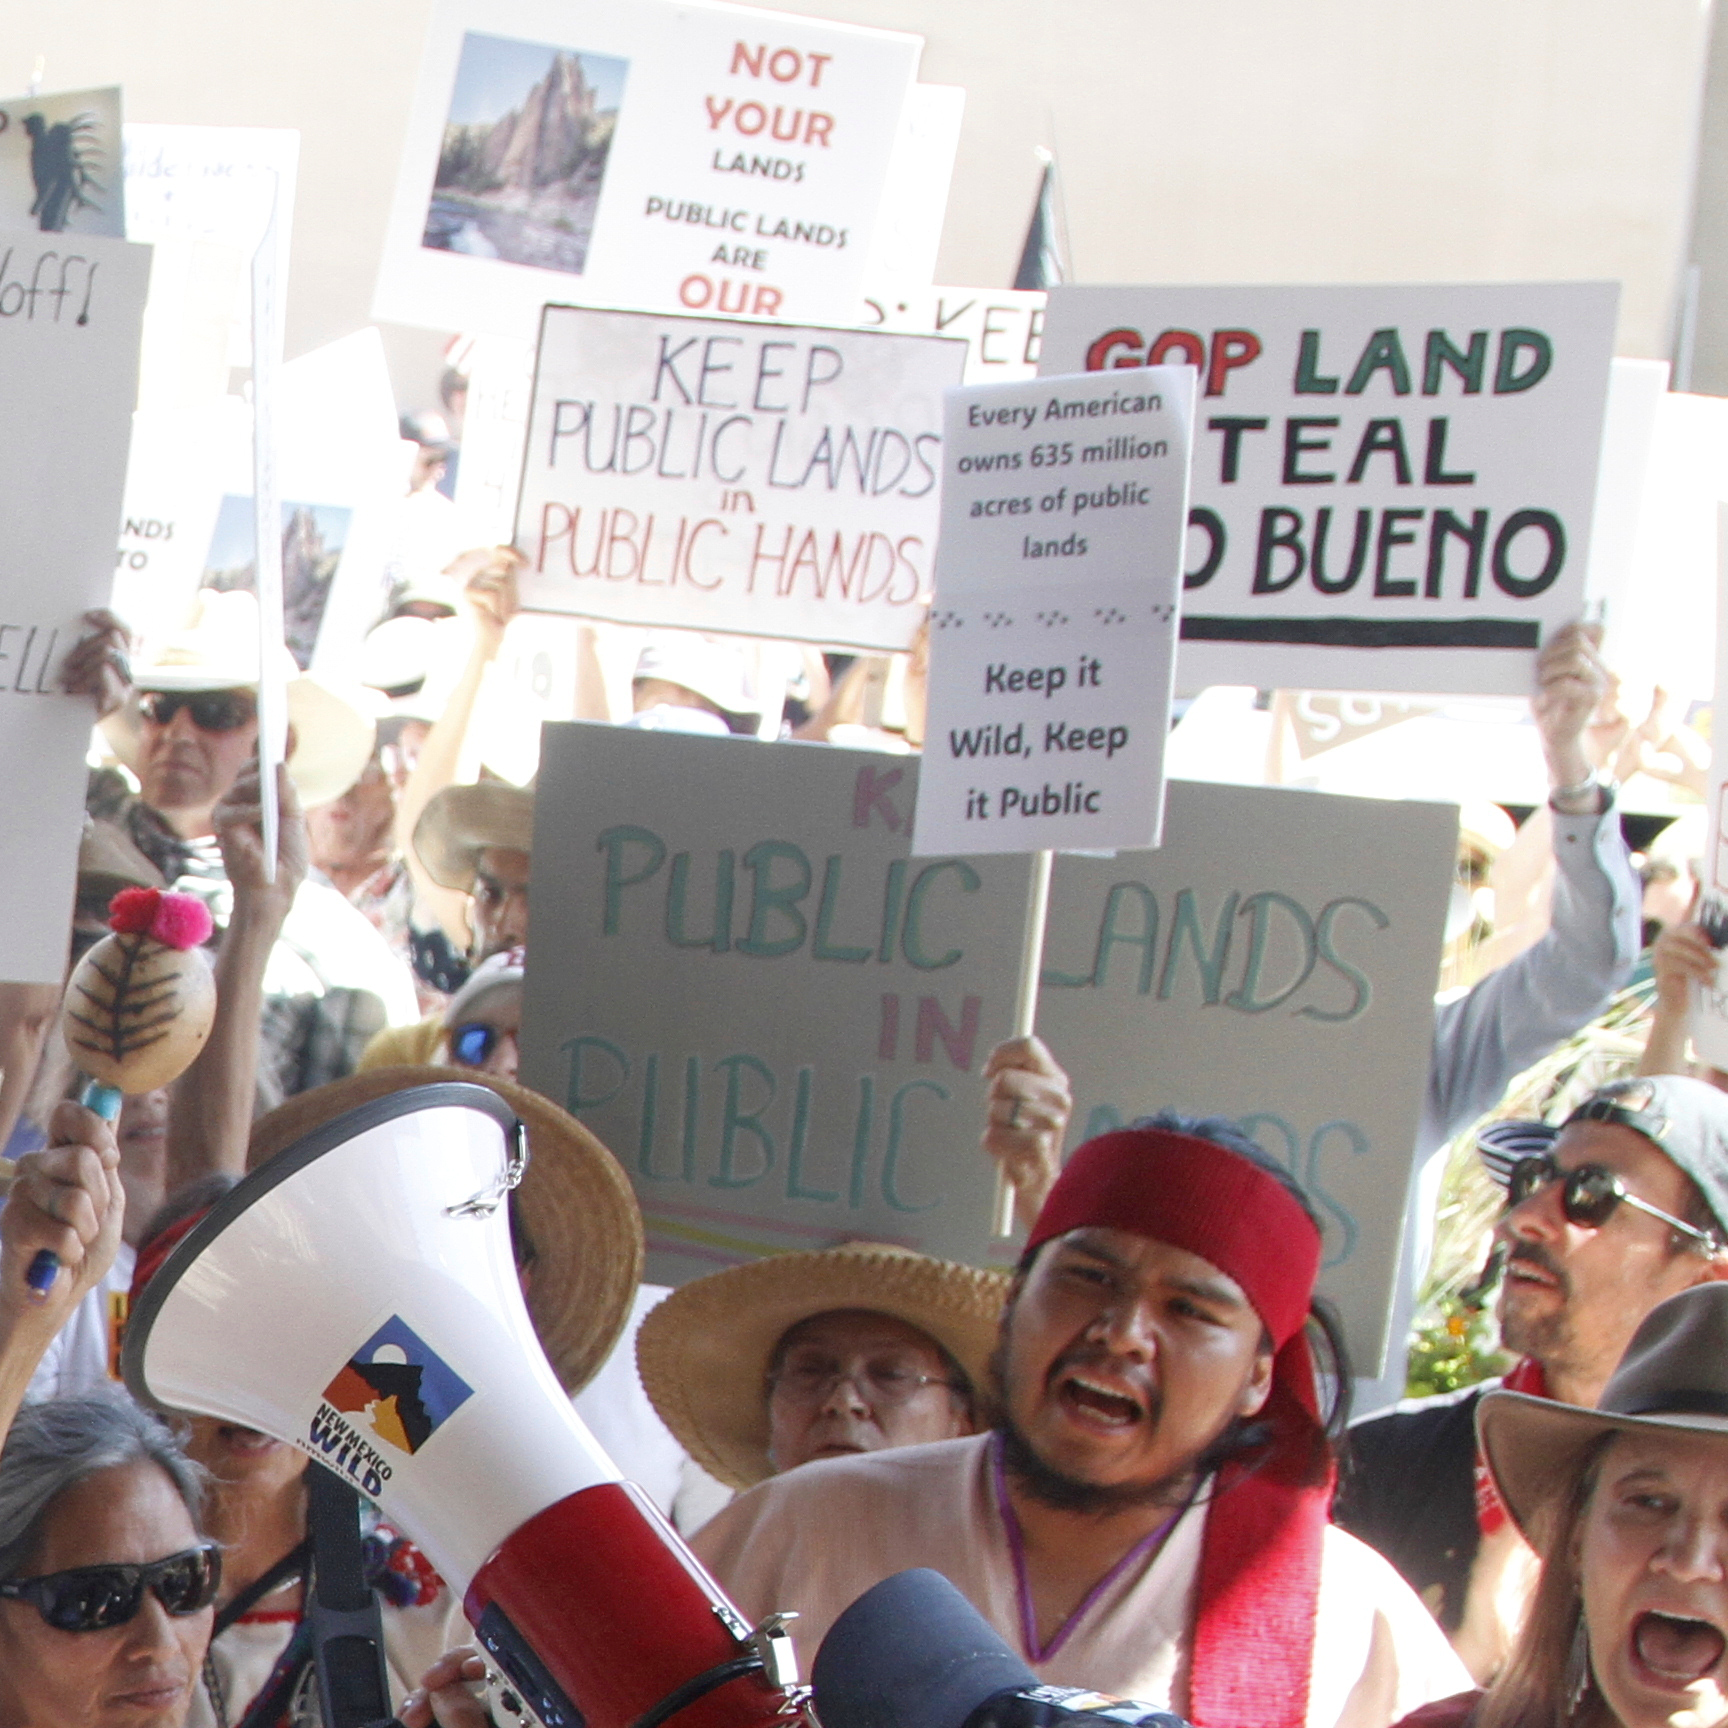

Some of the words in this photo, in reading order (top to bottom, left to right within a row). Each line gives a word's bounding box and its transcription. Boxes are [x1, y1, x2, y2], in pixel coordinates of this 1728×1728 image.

[729, 41, 834, 88] NOT
[703, 94, 836, 149] YOUR
[712, 150, 809, 183] LANDS
[643, 196, 747, 233] PUBLIC
[754, 213, 851, 251] LANDS
[710, 243, 767, 271] ARE
[677, 272, 784, 316] OUR
[651, 334, 846, 414] KEEP
[1085, 328, 1262, 398] GOP
[1293, 327, 1555, 396] LAND
[967, 401, 1037, 430] Every
[1044, 389, 1163, 422] American
[547, 400, 754, 483] PUBLIC
[767, 419, 942, 500] LANDS
[957, 450, 1023, 475] owns
[1029, 441, 1075, 468] 635
[1081, 434, 1169, 465] million
[719, 488, 756, 514] in
[969, 492, 1033, 518] acres
[1039, 488, 1067, 514] of
[1072, 483, 1151, 515] public
[537, 502, 731, 592] PUBLIC
[746, 523, 930, 607] HANDS
[1021, 532, 1089, 562] lands
[1250, 506, 1567, 600] BUENO
[984, 661, 1066, 700] Keep
[1077, 656, 1102, 688] it
[948, 726, 1033, 761] Wild,
[1044, 718, 1129, 760] Keep
[964, 787, 991, 820] it
[999, 783, 1101, 819] Public
[594, 822, 985, 972] PUBLIC
[875, 993, 987, 1074] IN
[558, 1033, 952, 1215] PUBLIC
[309, 1415, 383, 1498] WILD
[316, 1403, 350, 1436] NEW
[344, 1429, 393, 1482] MEXICO
